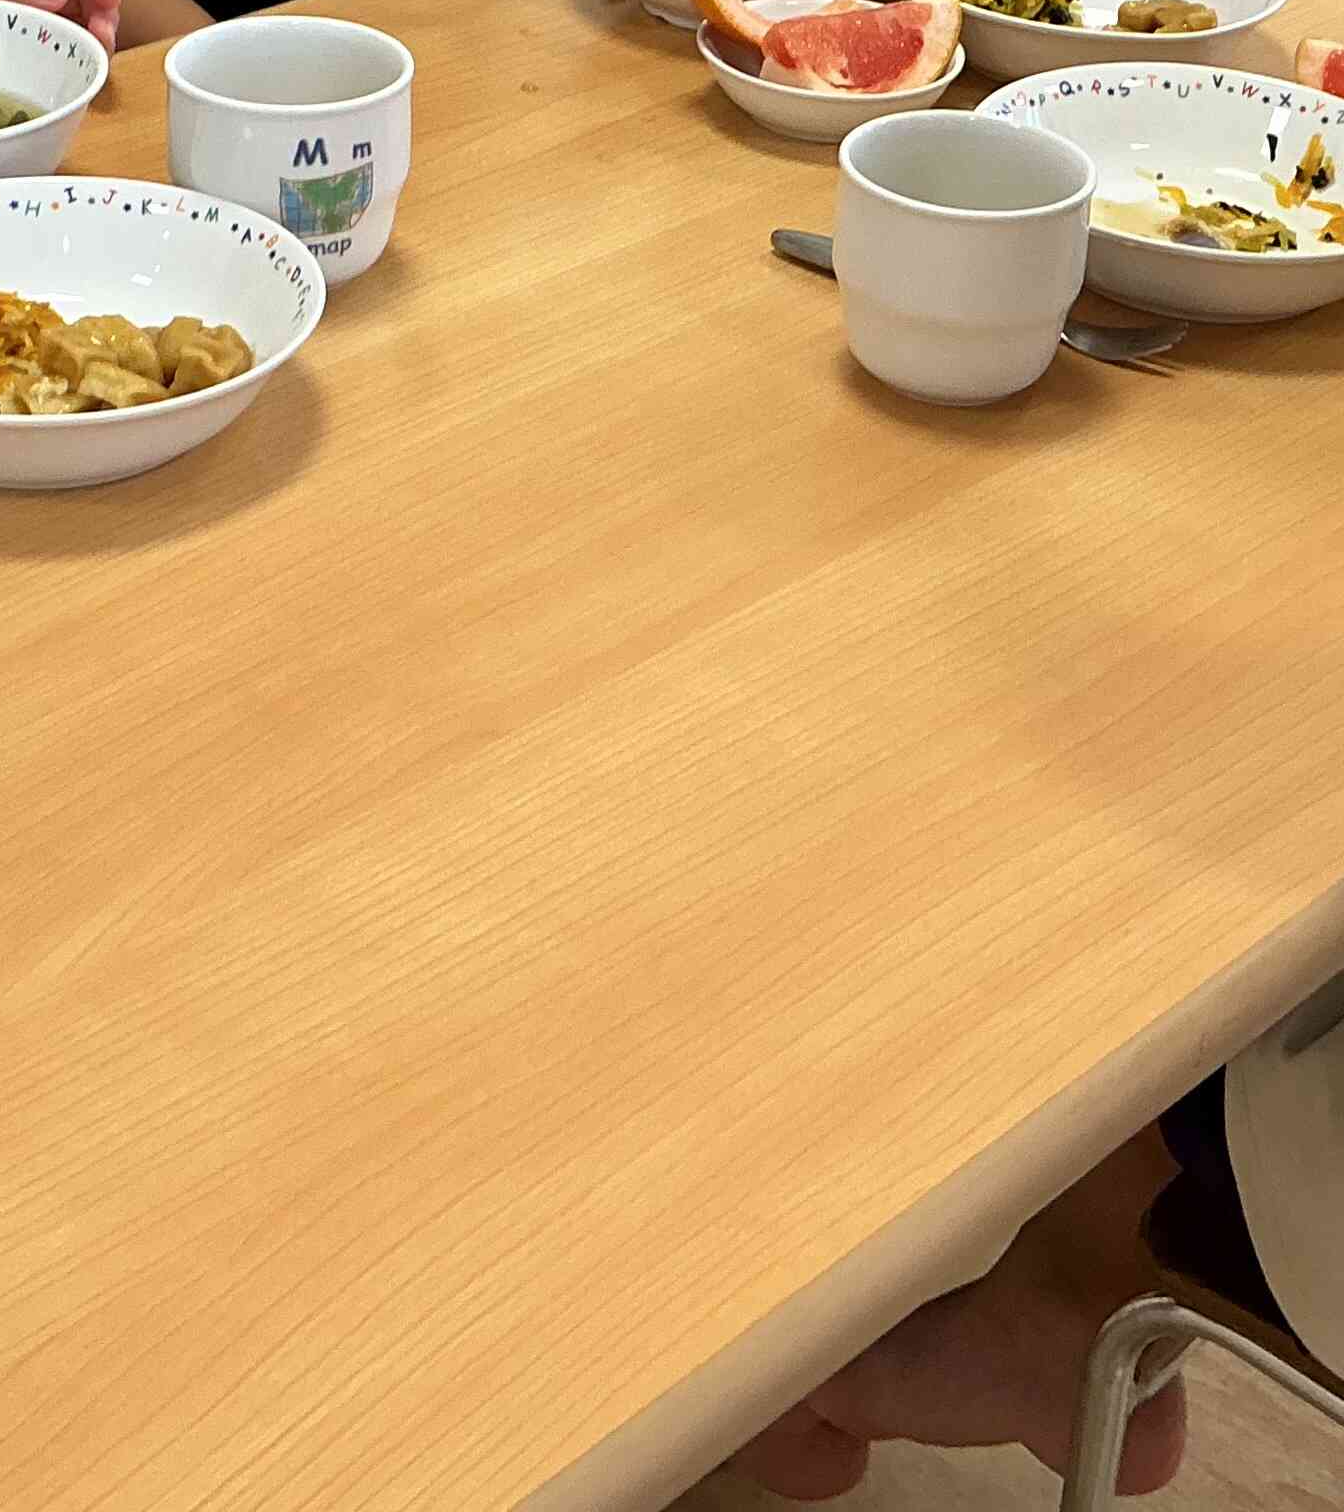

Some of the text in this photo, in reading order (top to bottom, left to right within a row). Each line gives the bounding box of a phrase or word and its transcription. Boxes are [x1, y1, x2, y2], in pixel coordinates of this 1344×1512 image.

[292, 137, 373, 168] M m
[306, 238, 353, 257] map
